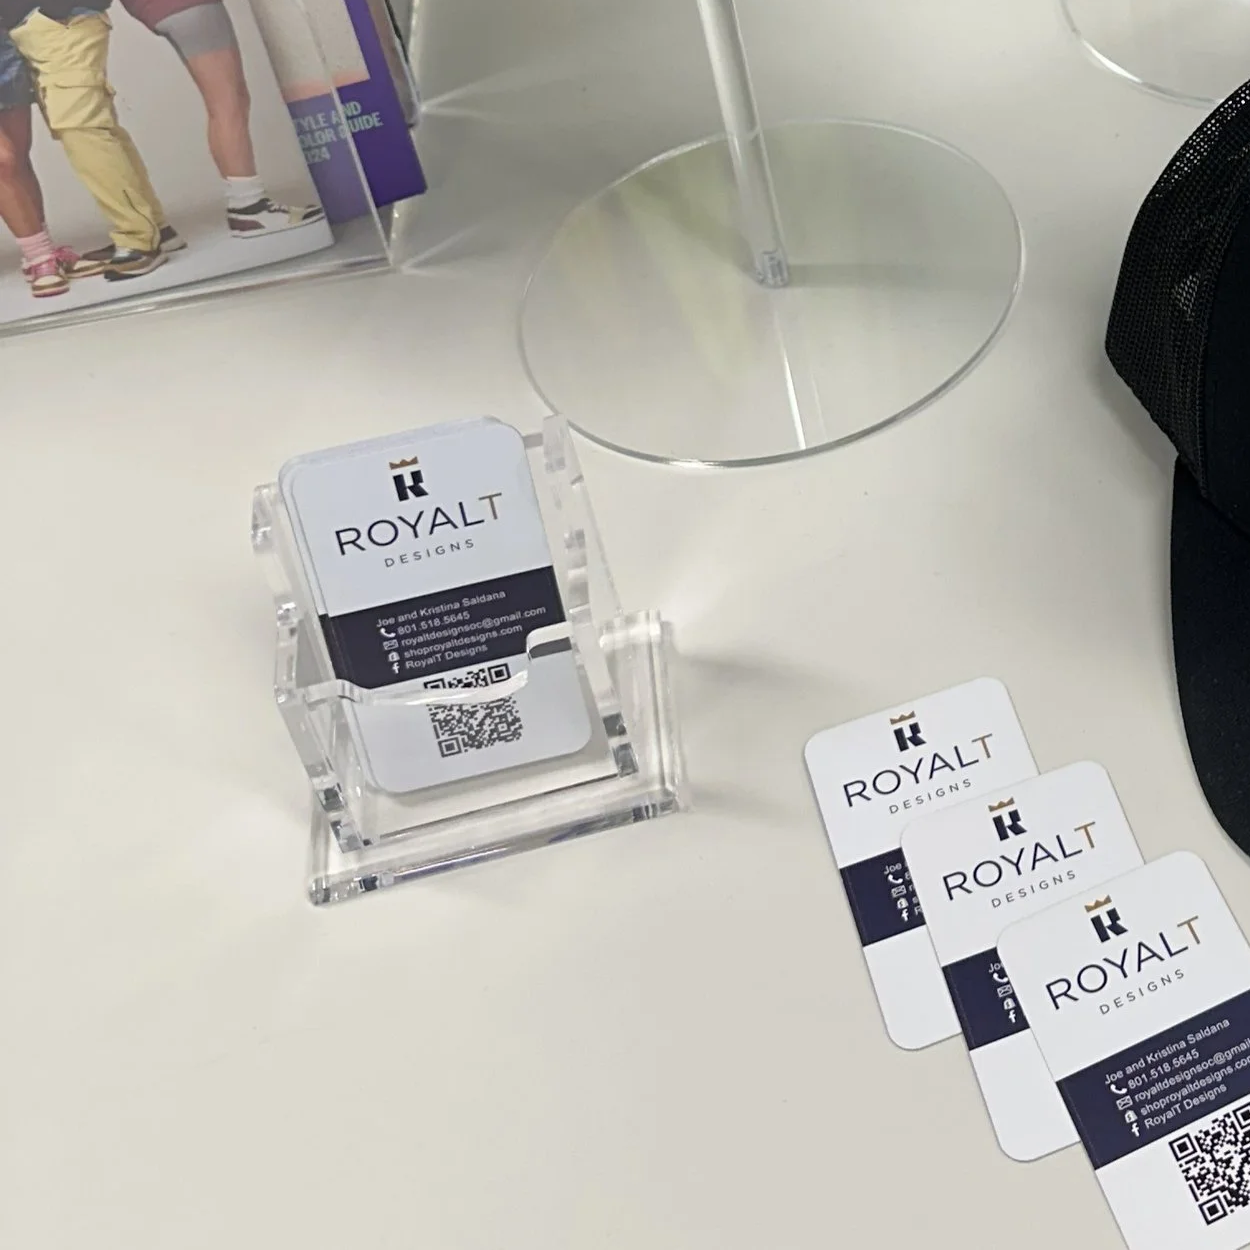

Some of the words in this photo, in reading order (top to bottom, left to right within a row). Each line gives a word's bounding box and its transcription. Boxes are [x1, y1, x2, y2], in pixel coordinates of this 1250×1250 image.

[335, 492, 502, 556] ROYALT
[384, 538, 476, 568] DESIGNS
[376, 616, 395, 628] Joe
[398, 611, 418, 622] and
[419, 601, 460, 617] Kristina
[462, 590, 507, 606] Saldana
[397, 611, 471, 635] 801.518.5645
[401, 606, 546, 648] royaltdesignsoc@gmail.com
[404, 624, 523, 659] shoproyaltdesigns.com
[405, 654, 442, 670] RoyalT
[445, 643, 489, 661] Designs
[843, 733, 993, 808] ROYALT
[889, 778, 973, 814] DESIGNS
[883, 862, 902, 875] Joe
[942, 821, 1096, 901] ROYALT
[991, 870, 1077, 908] DESIGNS
[1045, 915, 1201, 1011] ROYALT
[1099, 968, 1185, 1015] DESIGNS
[1104, 1070, 1124, 1085] Joe
[1125, 1058, 1146, 1074] and
[1146, 1039, 1187, 1064] Kristina
[1186, 1018, 1231, 1044] Saldana
[1127, 1048, 1200, 1090] 801.518.5645
[1144, 1103, 1182, 1129] RoyalT
[1183, 1082, 1228, 1110] Designs
